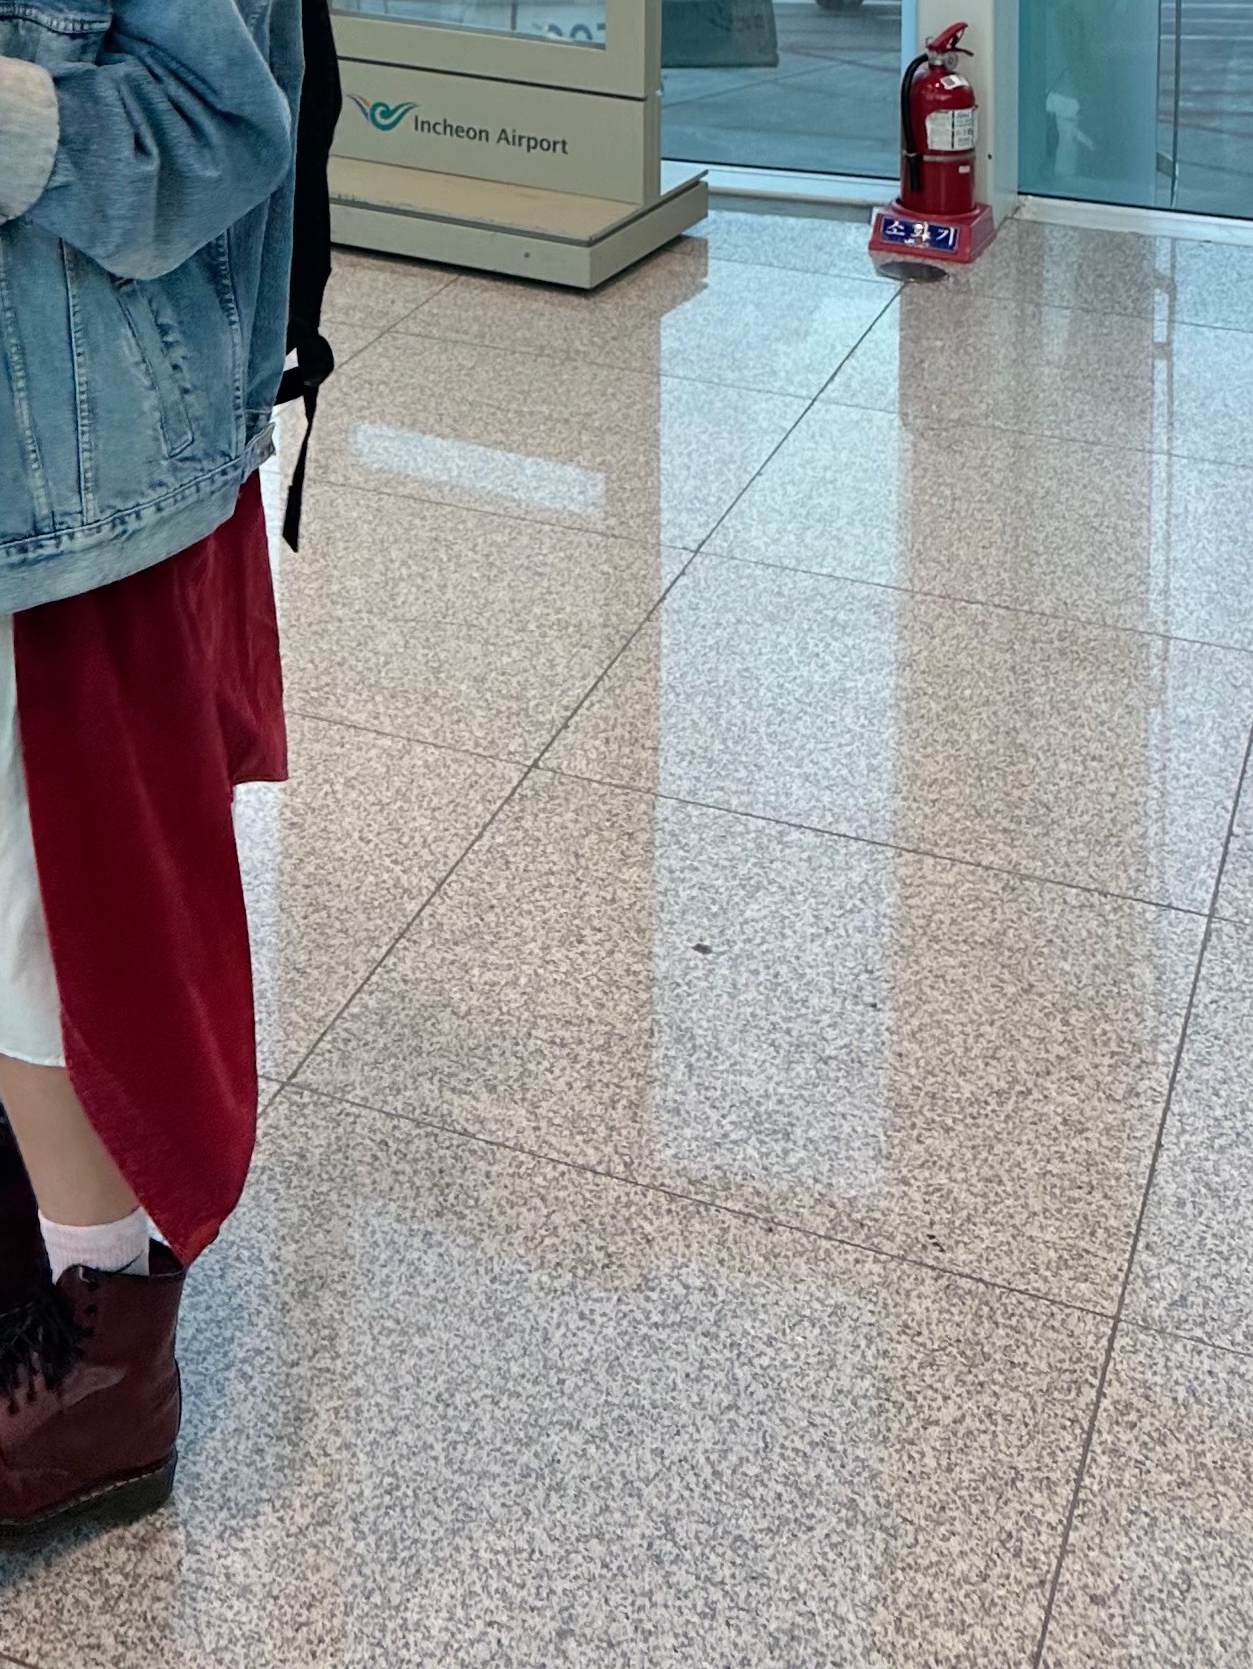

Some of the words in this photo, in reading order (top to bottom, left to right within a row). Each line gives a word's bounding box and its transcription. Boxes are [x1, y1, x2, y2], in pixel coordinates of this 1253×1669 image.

[413, 114, 490, 143] Incheon
[496, 129, 569, 155] Airport
[884, 219, 955, 247] 소화기
